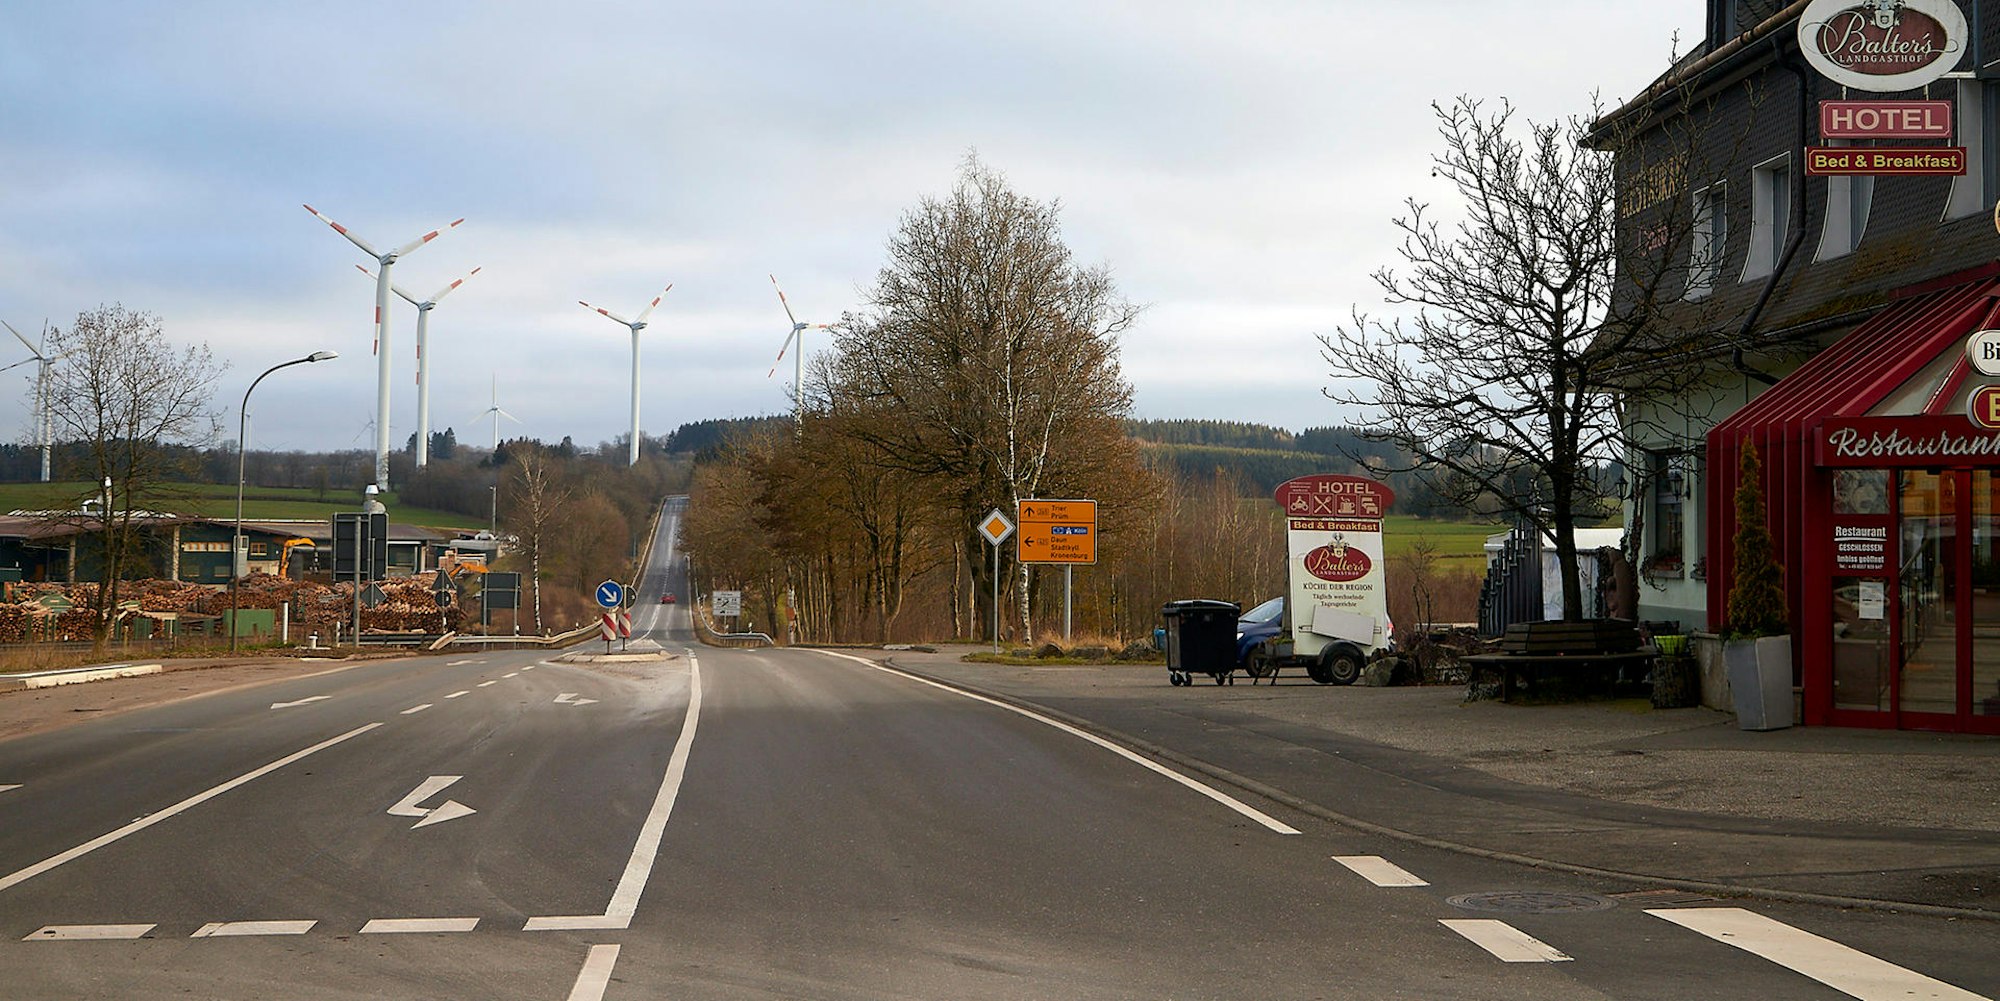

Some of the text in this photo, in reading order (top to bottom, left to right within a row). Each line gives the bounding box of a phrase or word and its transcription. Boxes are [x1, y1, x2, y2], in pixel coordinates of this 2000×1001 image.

[1808, 10, 1945, 66] Balter's
[1839, 54, 1923, 63] LANDGASTHOF
[1832, 108, 1943, 130] HOTEL
[1815, 154, 1957, 168] Bed & Breakfast
[1319, 481, 1375, 494] HOTEL
[1294, 521, 1377, 531] Bed & Breakfast
[1835, 526, 1886, 537] Restaurant
[1303, 582, 1327, 590] KÜCHE
